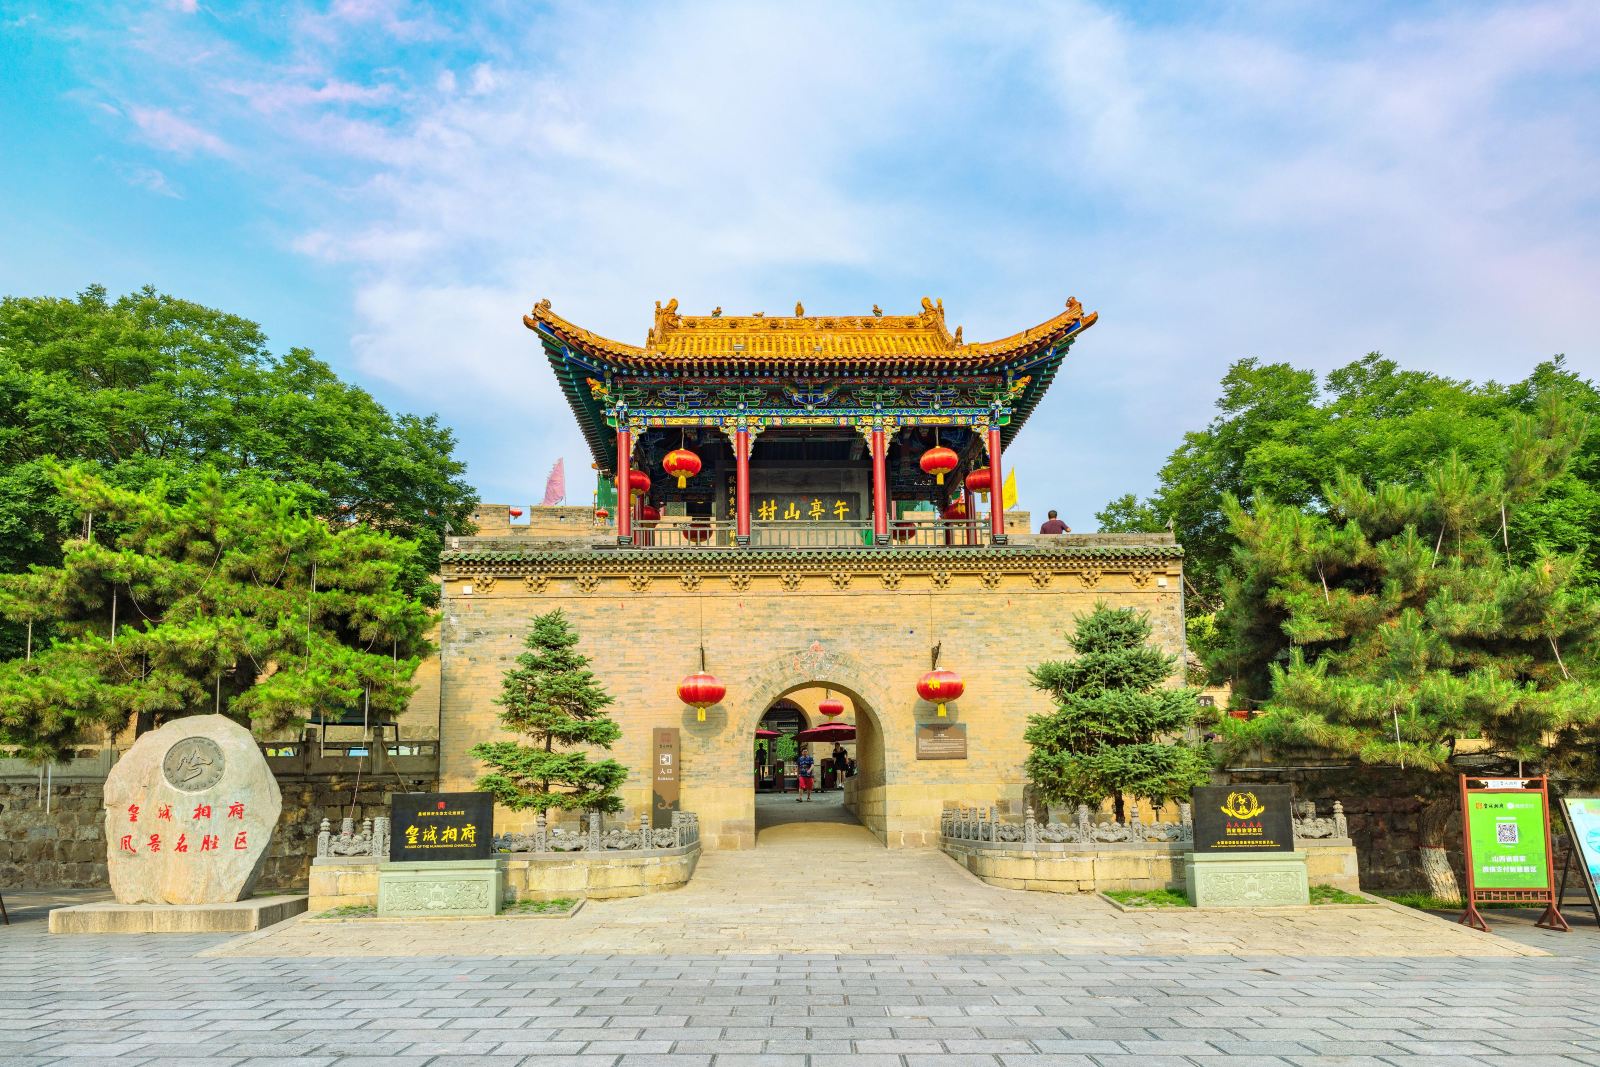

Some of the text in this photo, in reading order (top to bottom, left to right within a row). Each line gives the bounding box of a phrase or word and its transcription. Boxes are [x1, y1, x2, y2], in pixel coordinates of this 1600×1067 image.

[127, 801, 245, 823] 皇城相府
[120, 831, 248, 854] 风景名胜区
[404, 823, 477, 845] 皇城相府
